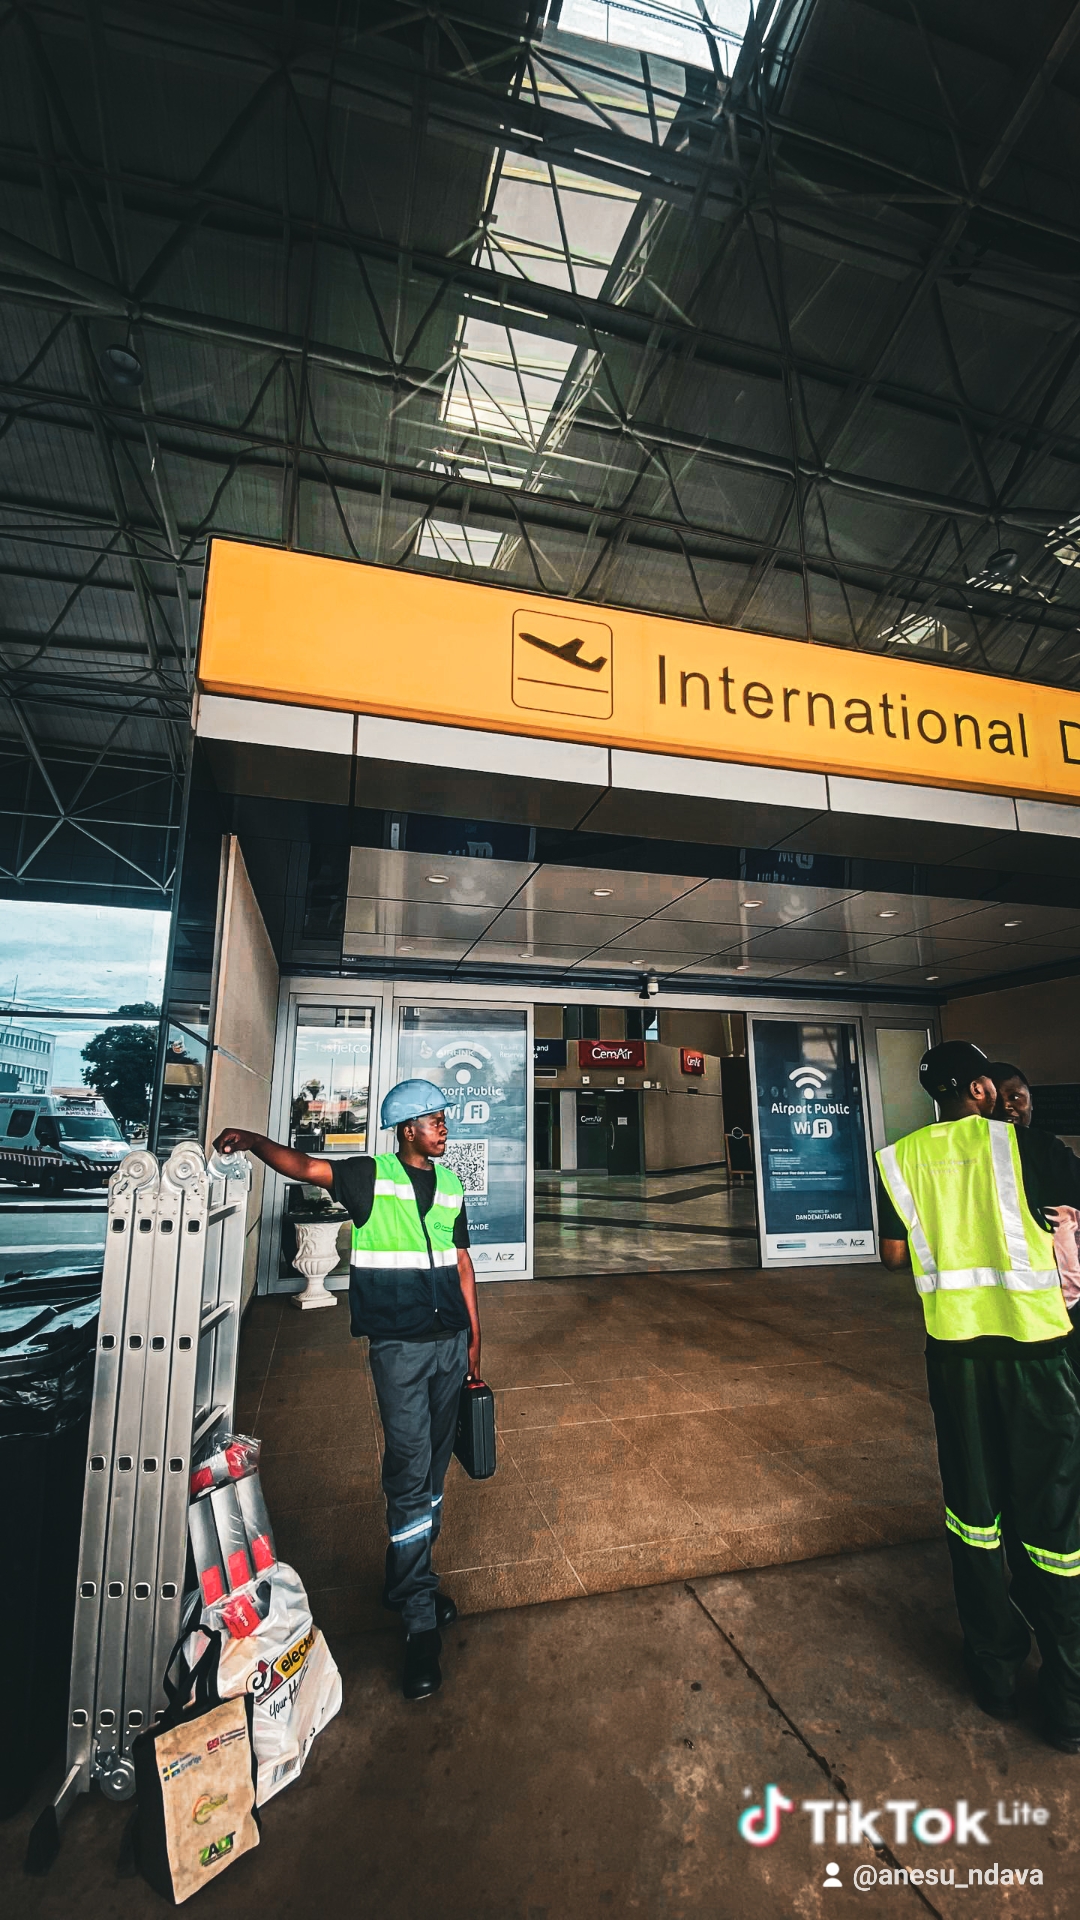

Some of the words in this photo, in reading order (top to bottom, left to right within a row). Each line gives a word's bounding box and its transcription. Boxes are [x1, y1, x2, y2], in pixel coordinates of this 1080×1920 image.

[658, 653, 1029, 758] International
[315, 1040, 371, 1055] fastjet.co
[591, 1047, 633, 1060] CemAir
[440, 1086, 465, 1096] port
[467, 1086, 502, 1096] Public
[771, 1102, 813, 1116] Airport
[814, 1103, 850, 1115] Public
[580, 1115, 602, 1123] CemAir
[795, 1213, 843, 1221] DANDEMUTANDE
